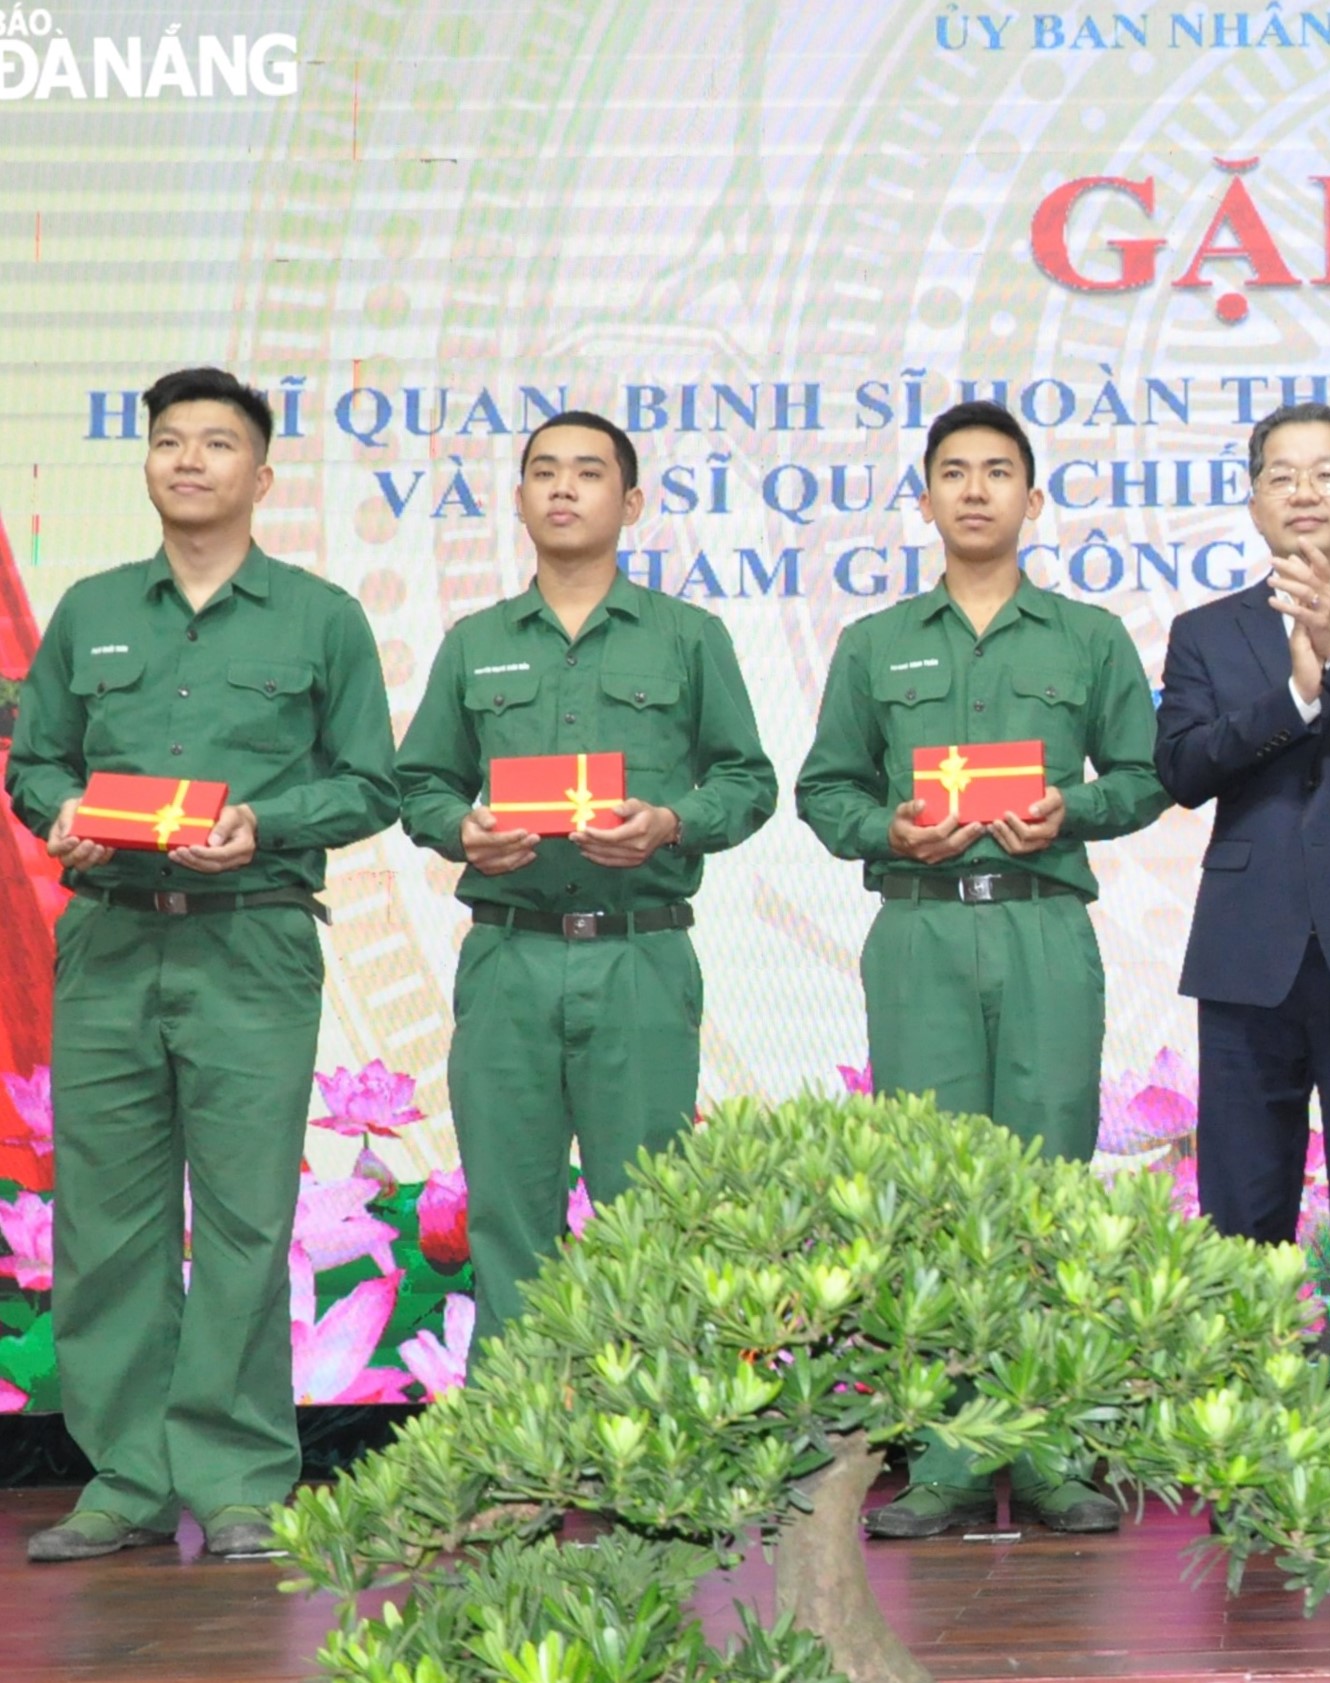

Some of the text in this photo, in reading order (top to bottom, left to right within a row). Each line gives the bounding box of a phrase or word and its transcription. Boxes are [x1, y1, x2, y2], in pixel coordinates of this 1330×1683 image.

[935, 3, 1013, 50] ỦY
[1033, 14, 1148, 49] BAN
[334, 386, 567, 448] QUAN
[622, 382, 823, 433] BINH
[855, 367, 928, 429] SĨ
[374, 455, 487, 519] VÀ
[661, 451, 730, 516] SĨ
[763, 463, 927, 525] QUA
[1048, 442, 1250, 510] CHIẾ
[617, 547, 804, 598] HAM
[833, 546, 928, 597] GI
[1018, 527, 1248, 594] CÔNG
